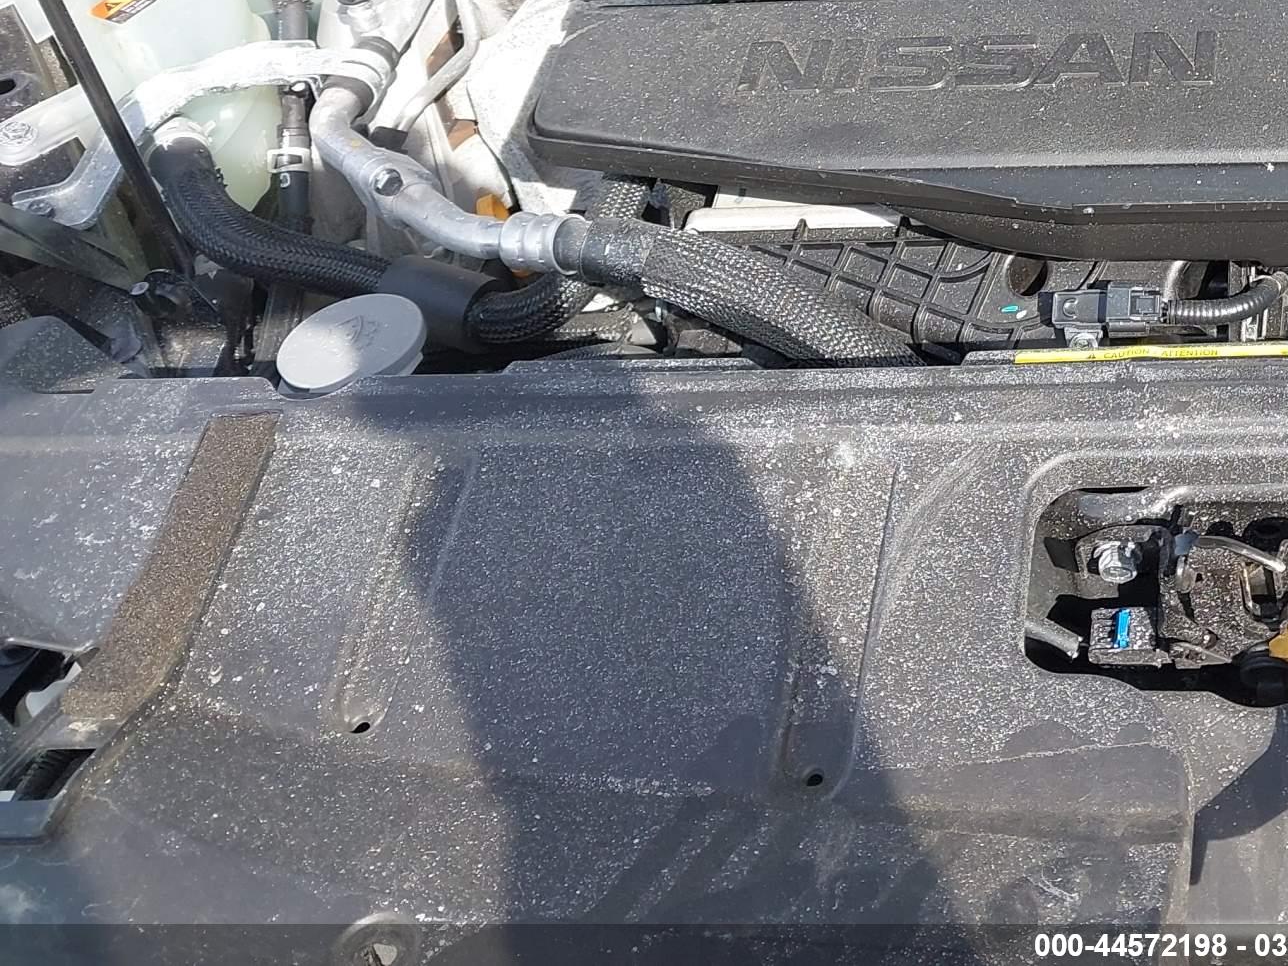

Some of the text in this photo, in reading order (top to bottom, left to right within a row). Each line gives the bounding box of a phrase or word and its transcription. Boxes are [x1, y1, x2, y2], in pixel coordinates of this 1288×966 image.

[734, 30, 1221, 96] NISSAN
[1103, 348, 1150, 359] CAUTION
[1160, 348, 1219, 357] ATTENTION
